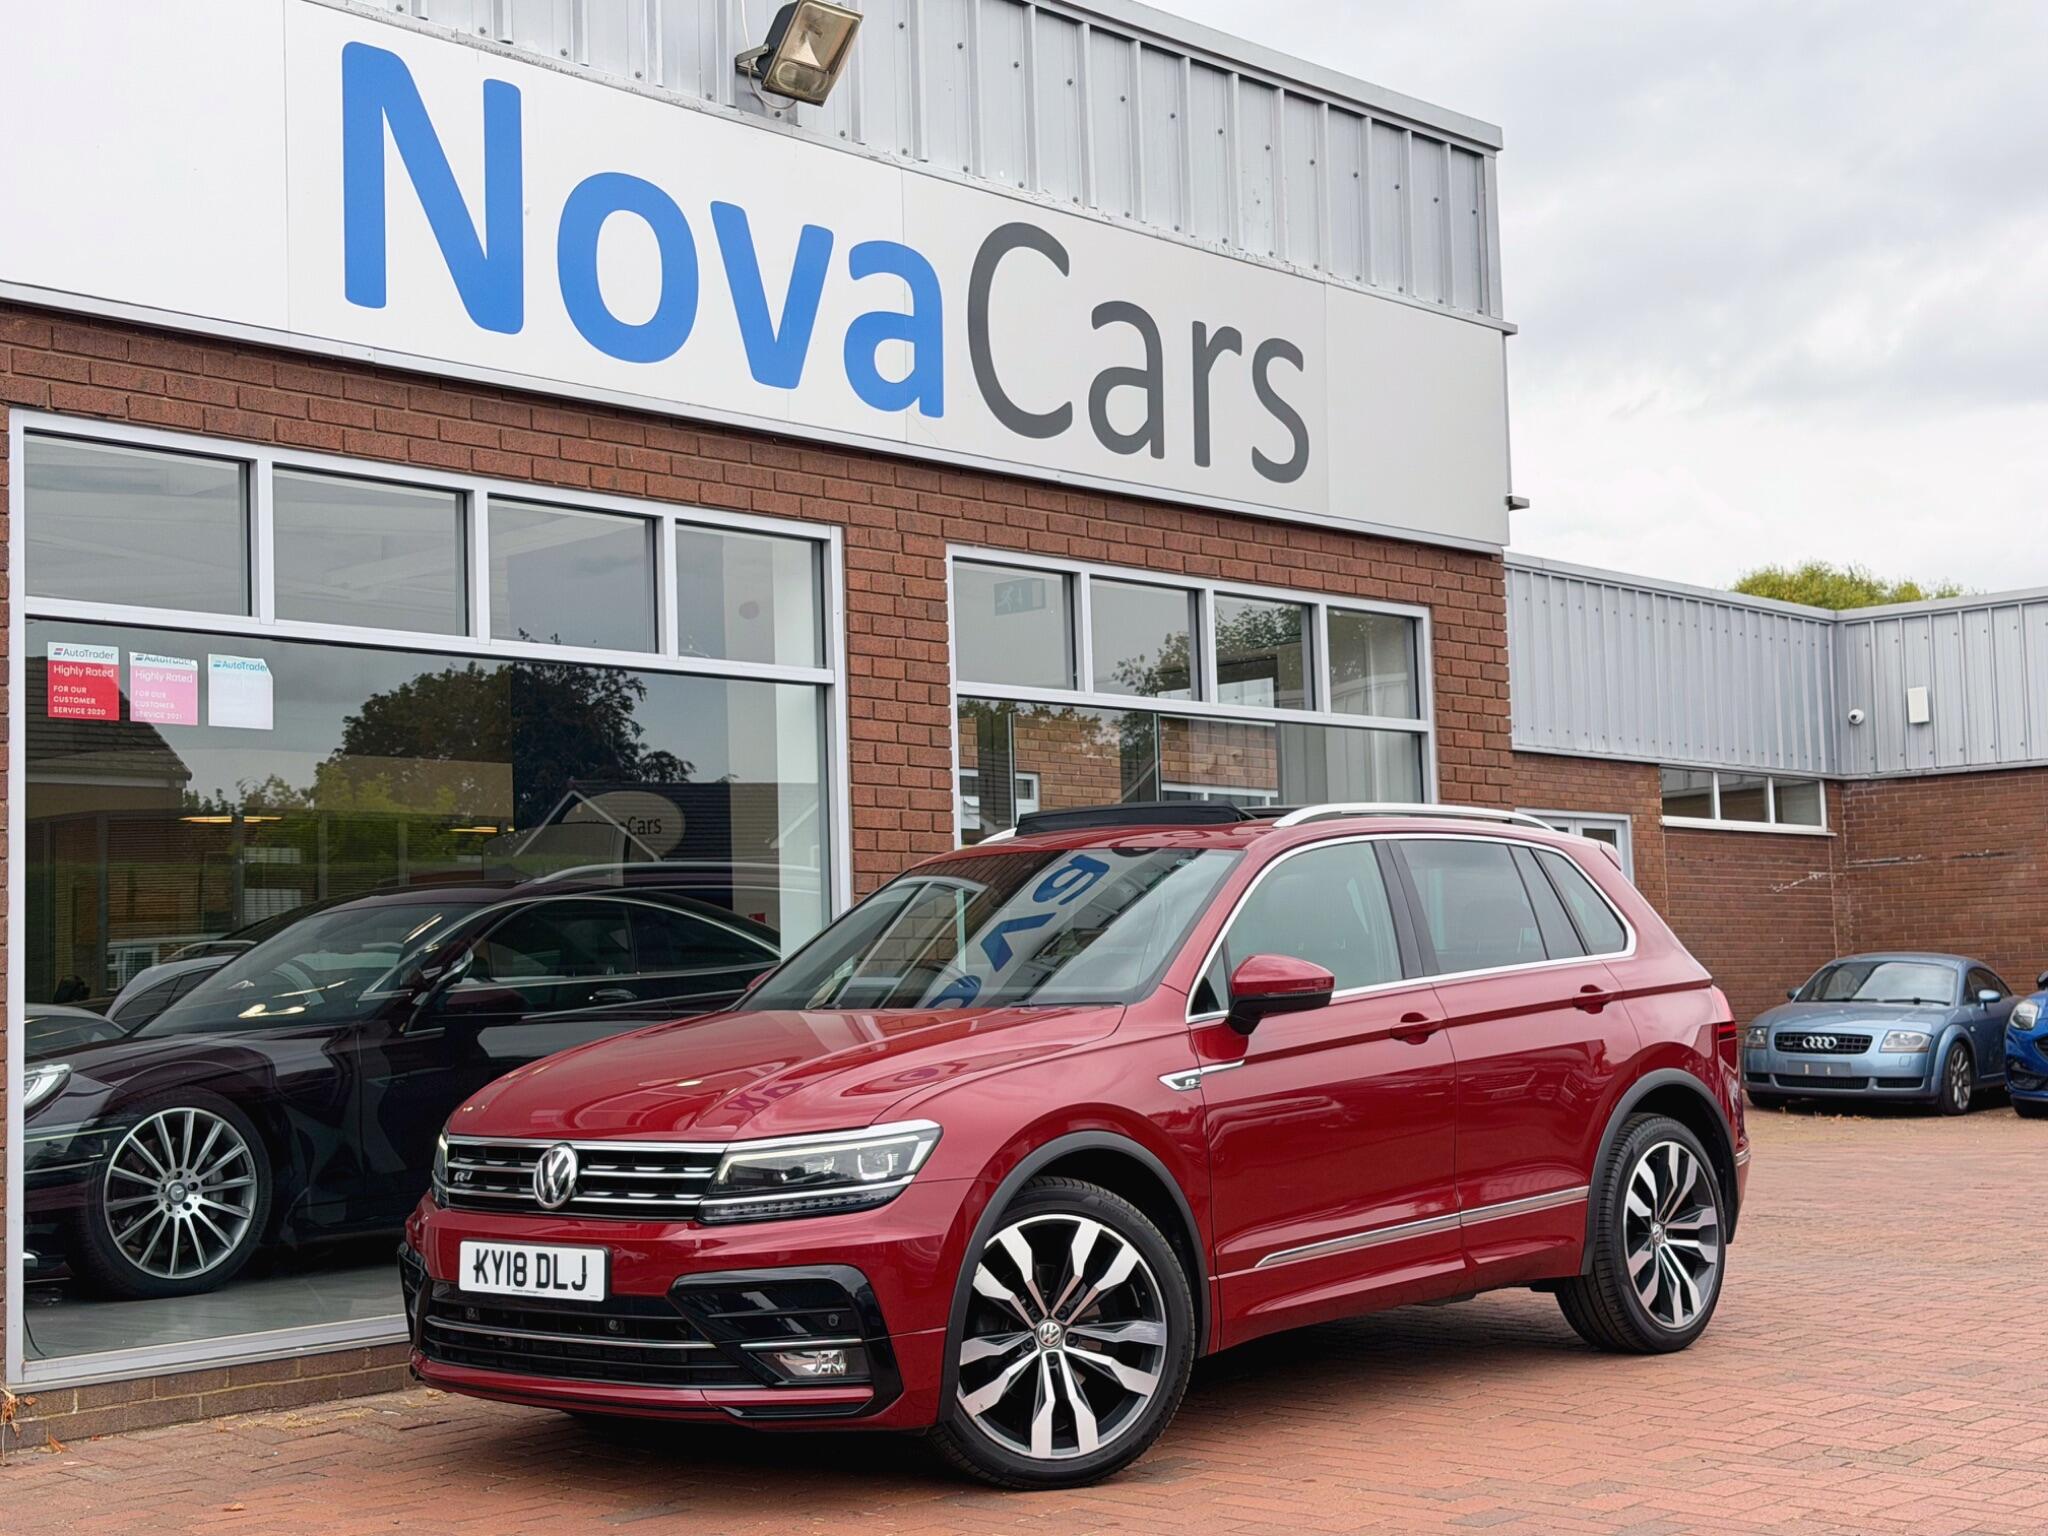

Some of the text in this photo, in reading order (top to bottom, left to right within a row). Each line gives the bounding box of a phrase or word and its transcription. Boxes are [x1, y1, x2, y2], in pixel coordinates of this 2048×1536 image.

[63, 648, 115, 660] AutoTrader
[53, 664, 114, 679] Highly Rated
[135, 669, 164, 683] Highly
[53, 685, 87, 694] FOR OUR
[53, 695, 96, 705] CUSTOMER
[53, 706, 85, 715] SERVICE
[618, 816, 662, 836] Cars
[473, 1248, 588, 1292] KY18 DLJ
